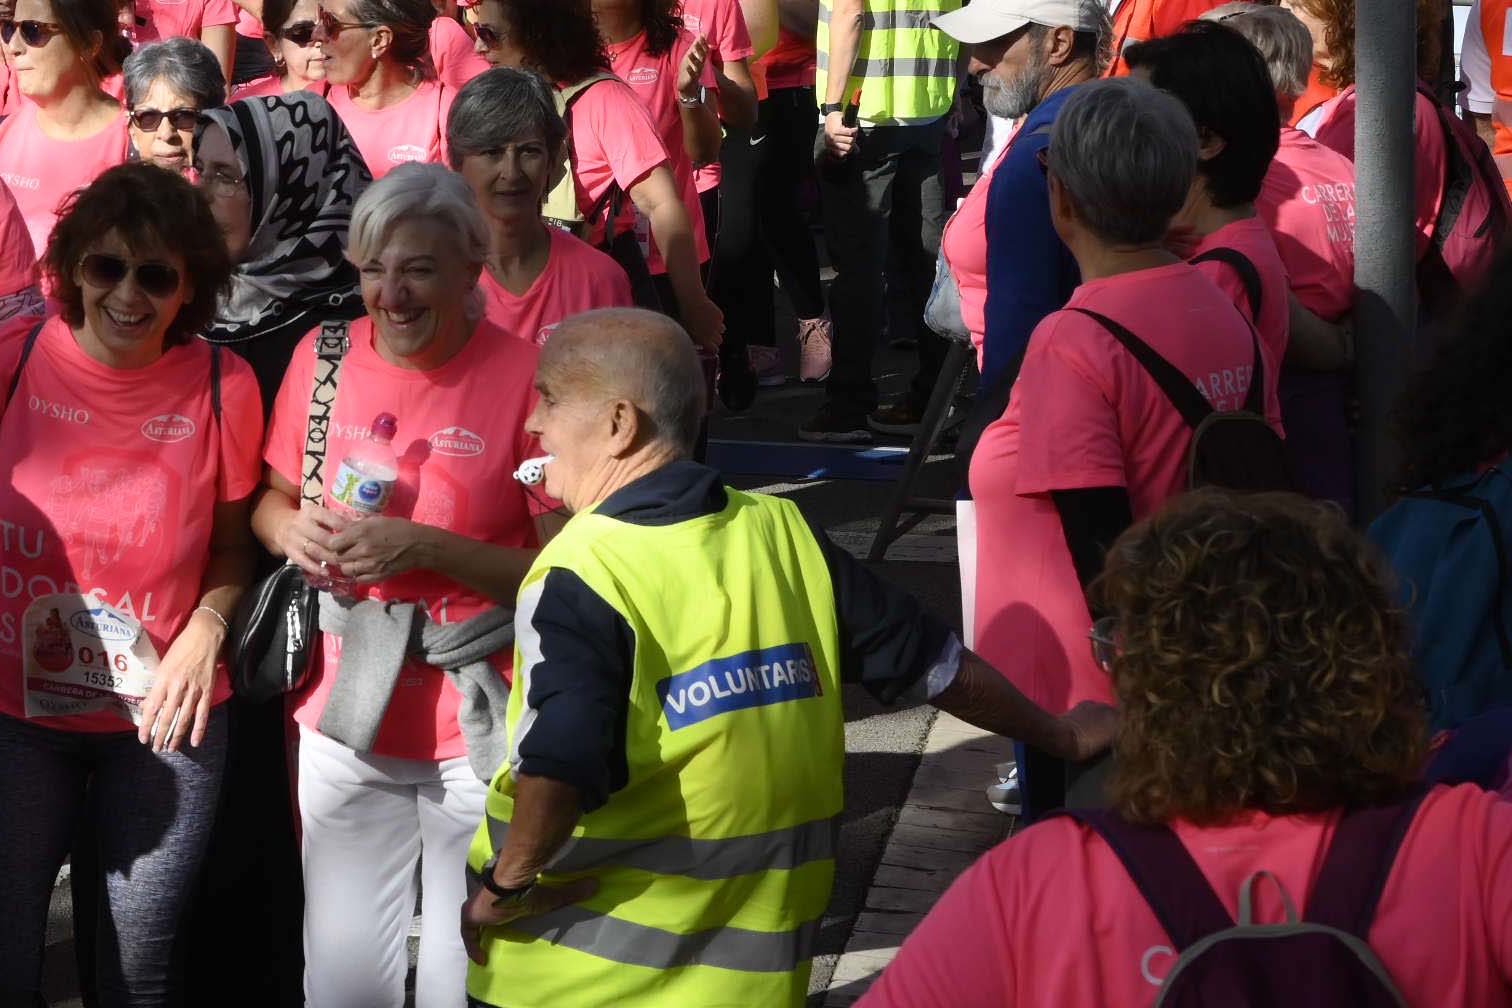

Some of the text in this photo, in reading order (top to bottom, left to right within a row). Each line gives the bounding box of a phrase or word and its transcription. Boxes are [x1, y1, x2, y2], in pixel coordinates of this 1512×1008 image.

[29, 395, 90, 425] OYSHO
[431, 436, 481, 453] ASTURIANA
[0, 519, 44, 559] TU
[76, 614, 132, 638] ASTURIANA
[79, 646, 128, 673] 016
[84, 671, 123, 689] 15352
